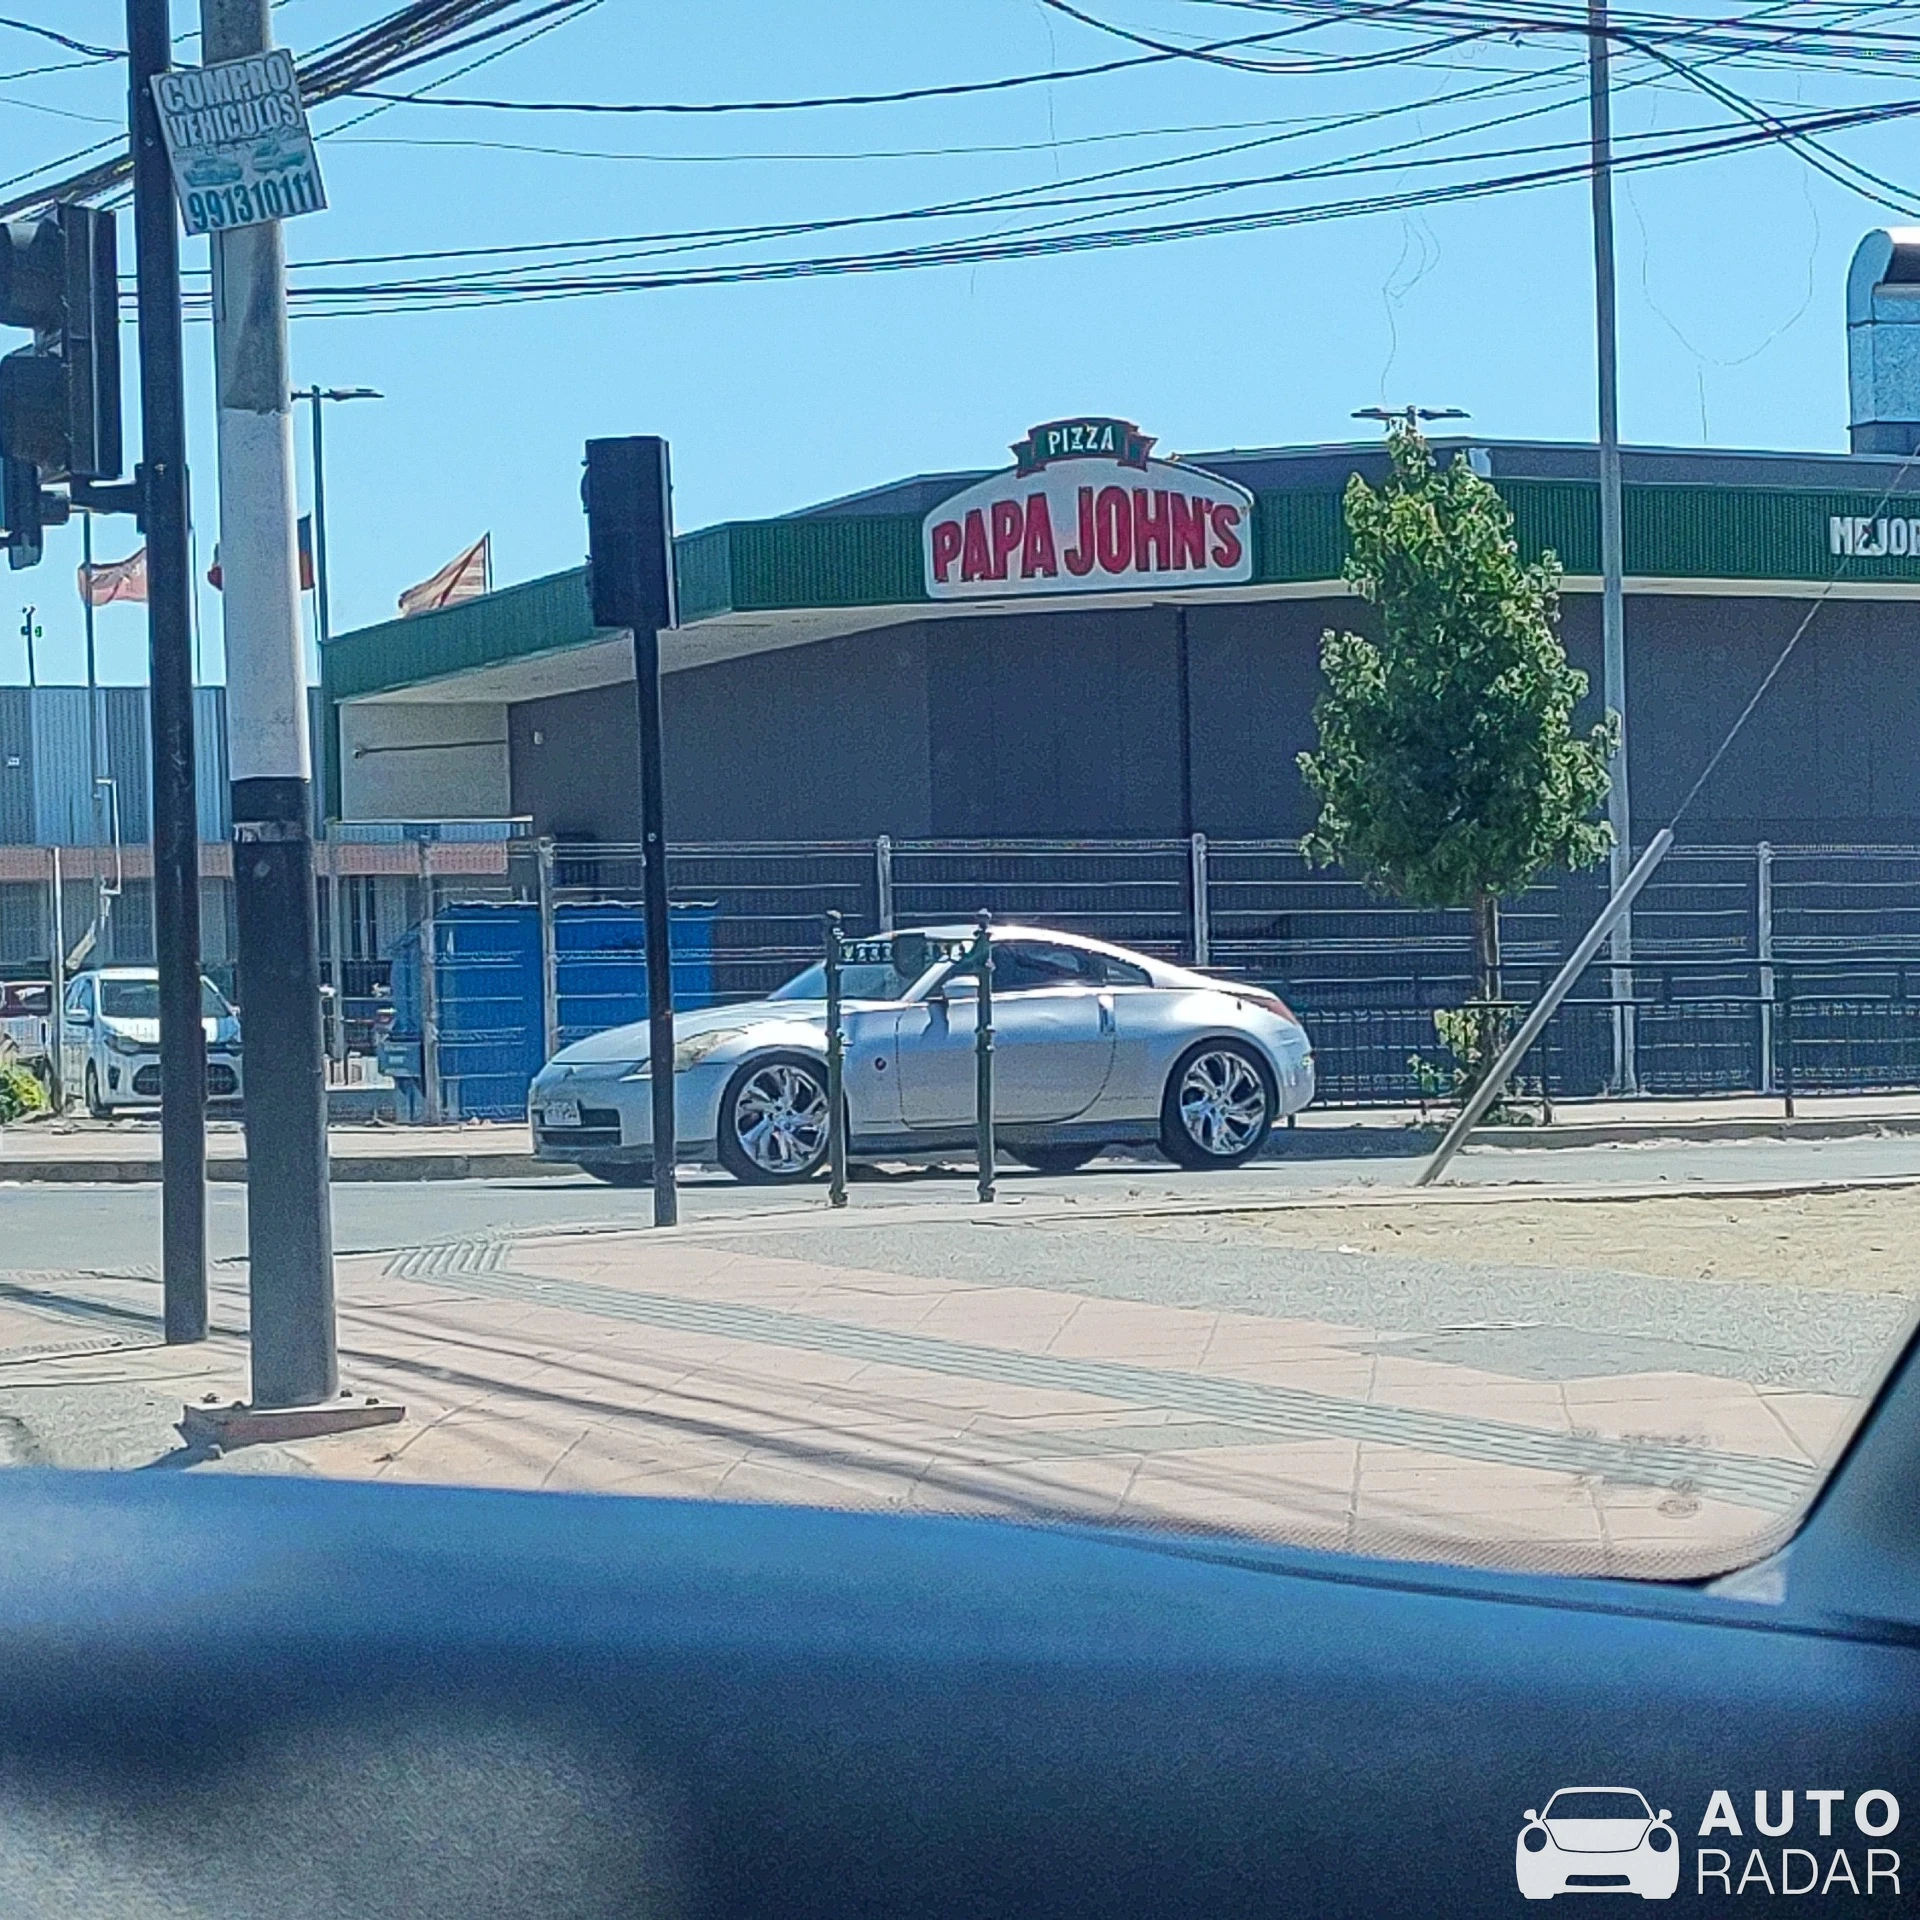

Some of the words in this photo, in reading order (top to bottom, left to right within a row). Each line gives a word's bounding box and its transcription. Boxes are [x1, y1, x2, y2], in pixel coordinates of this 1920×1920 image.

[160, 54, 291, 115] COMPRO
[167, 93, 299, 148] VEHICULOS
[187, 172, 319, 228] 991310111
[1048, 425, 1114, 454] PIZZA
[931, 492, 1058, 582] PAPA
[1064, 486, 1242, 576] JOHN'S
